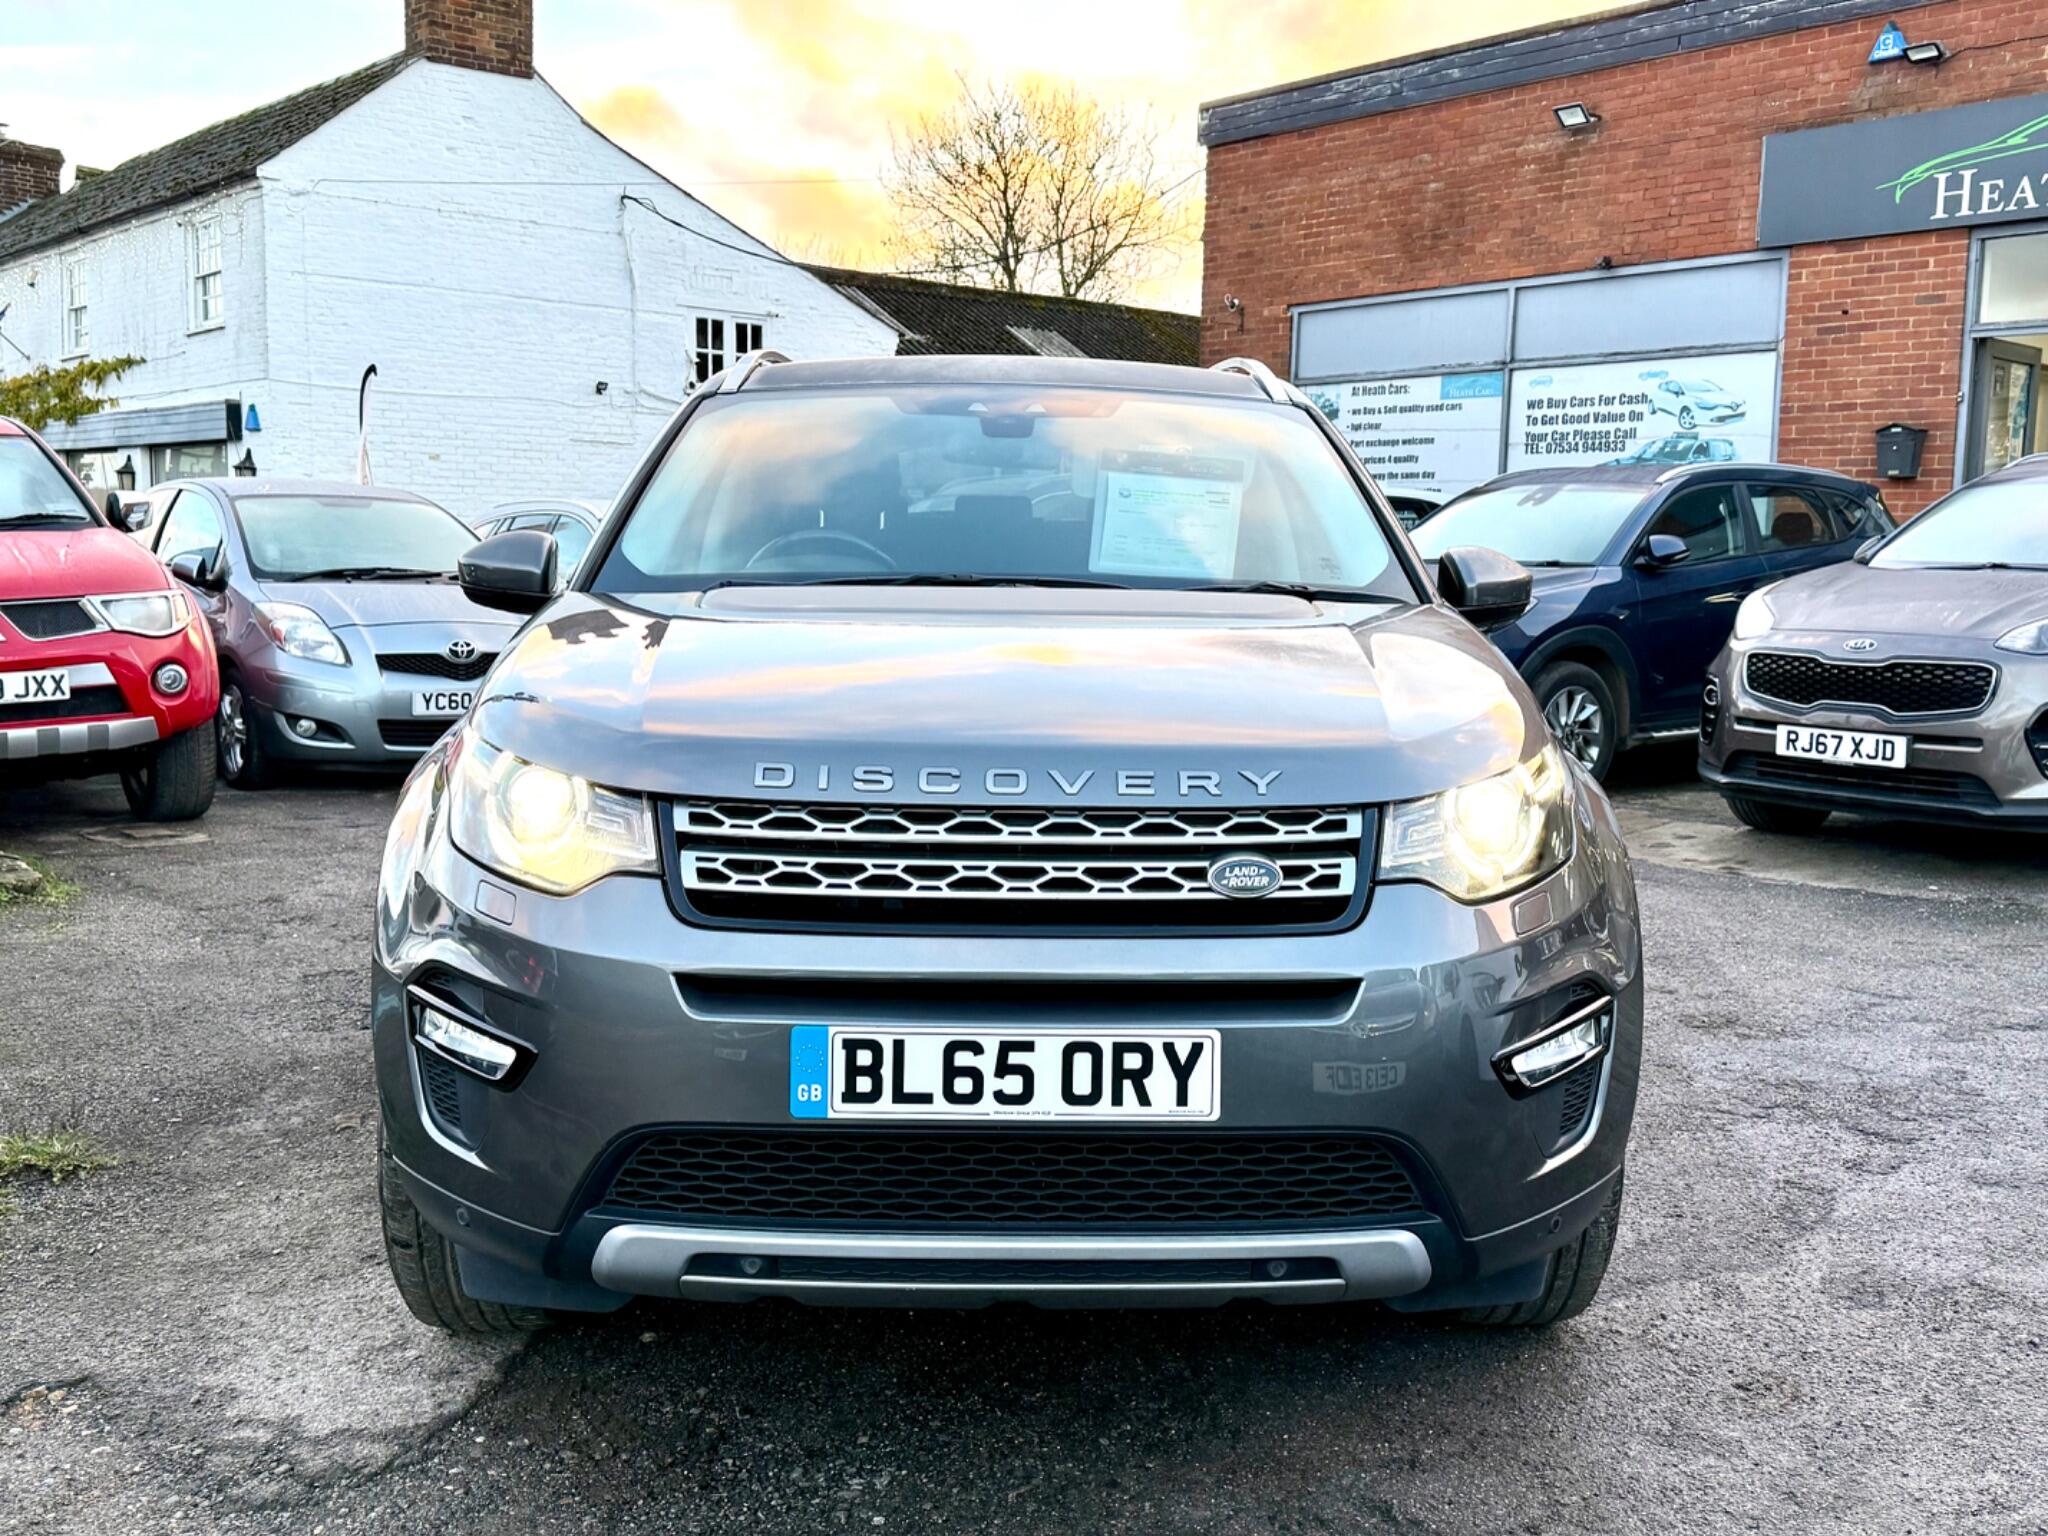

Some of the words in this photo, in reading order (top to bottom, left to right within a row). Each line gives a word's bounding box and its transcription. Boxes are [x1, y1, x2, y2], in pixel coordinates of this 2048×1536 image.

[1351, 385, 1360, 397] At
[1361, 383, 1386, 397] Heath
[1387, 383, 1411, 396] Cars:
[1363, 406, 1376, 416] Buy
[1383, 405, 1398, 415] Sell
[1399, 404, 1425, 415] quality
[1425, 402, 1444, 412] used
[1445, 402, 1463, 412] cars
[1547, 397, 1567, 409] Buy
[1570, 395, 1596, 407] Cars
[1598, 394, 1617, 406] For
[1526, 415, 1538, 427] To
[1541, 414, 1559, 425] Get
[1561, 412, 1590, 424] Good
[1593, 411, 1626, 423] Value
[1628, 409, 1644, 422] On
[1363, 422, 1382, 431] clear
[1365, 438, 1400, 448] exchange
[1401, 436, 1435, 446] welcome
[1525, 431, 1548, 443] Your
[1551, 430, 1570, 442] Car
[1572, 428, 1611, 442] Please
[1613, 426, 1637, 440] Call
[1524, 443, 1543, 455] TEL:
[1545, 441, 1580, 454] 07534
[1582, 440, 1626, 453] 944933
[1363, 455, 1386, 465] prices
[1387, 454, 1392, 464] 4
[1393, 454, 1419, 464] quality
[1387, 471, 1399, 480] the
[1400, 471, 1420, 480] same
[1422, 470, 1436, 480] day
[14, 674, 66, 698] JXX
[422, 692, 472, 711] YC60
[1786, 730, 1843, 756] RJ67
[1850, 736, 1895, 761] XJD
[753, 760, 1282, 797] DISCOVERY
[1225, 866, 1258, 877] LAND
[1229, 876, 1269, 887] ROVER
[841, 1038, 1034, 1105] BL65
[1061, 1041, 1204, 1107] ORY
[797, 1084, 823, 1102] GB
